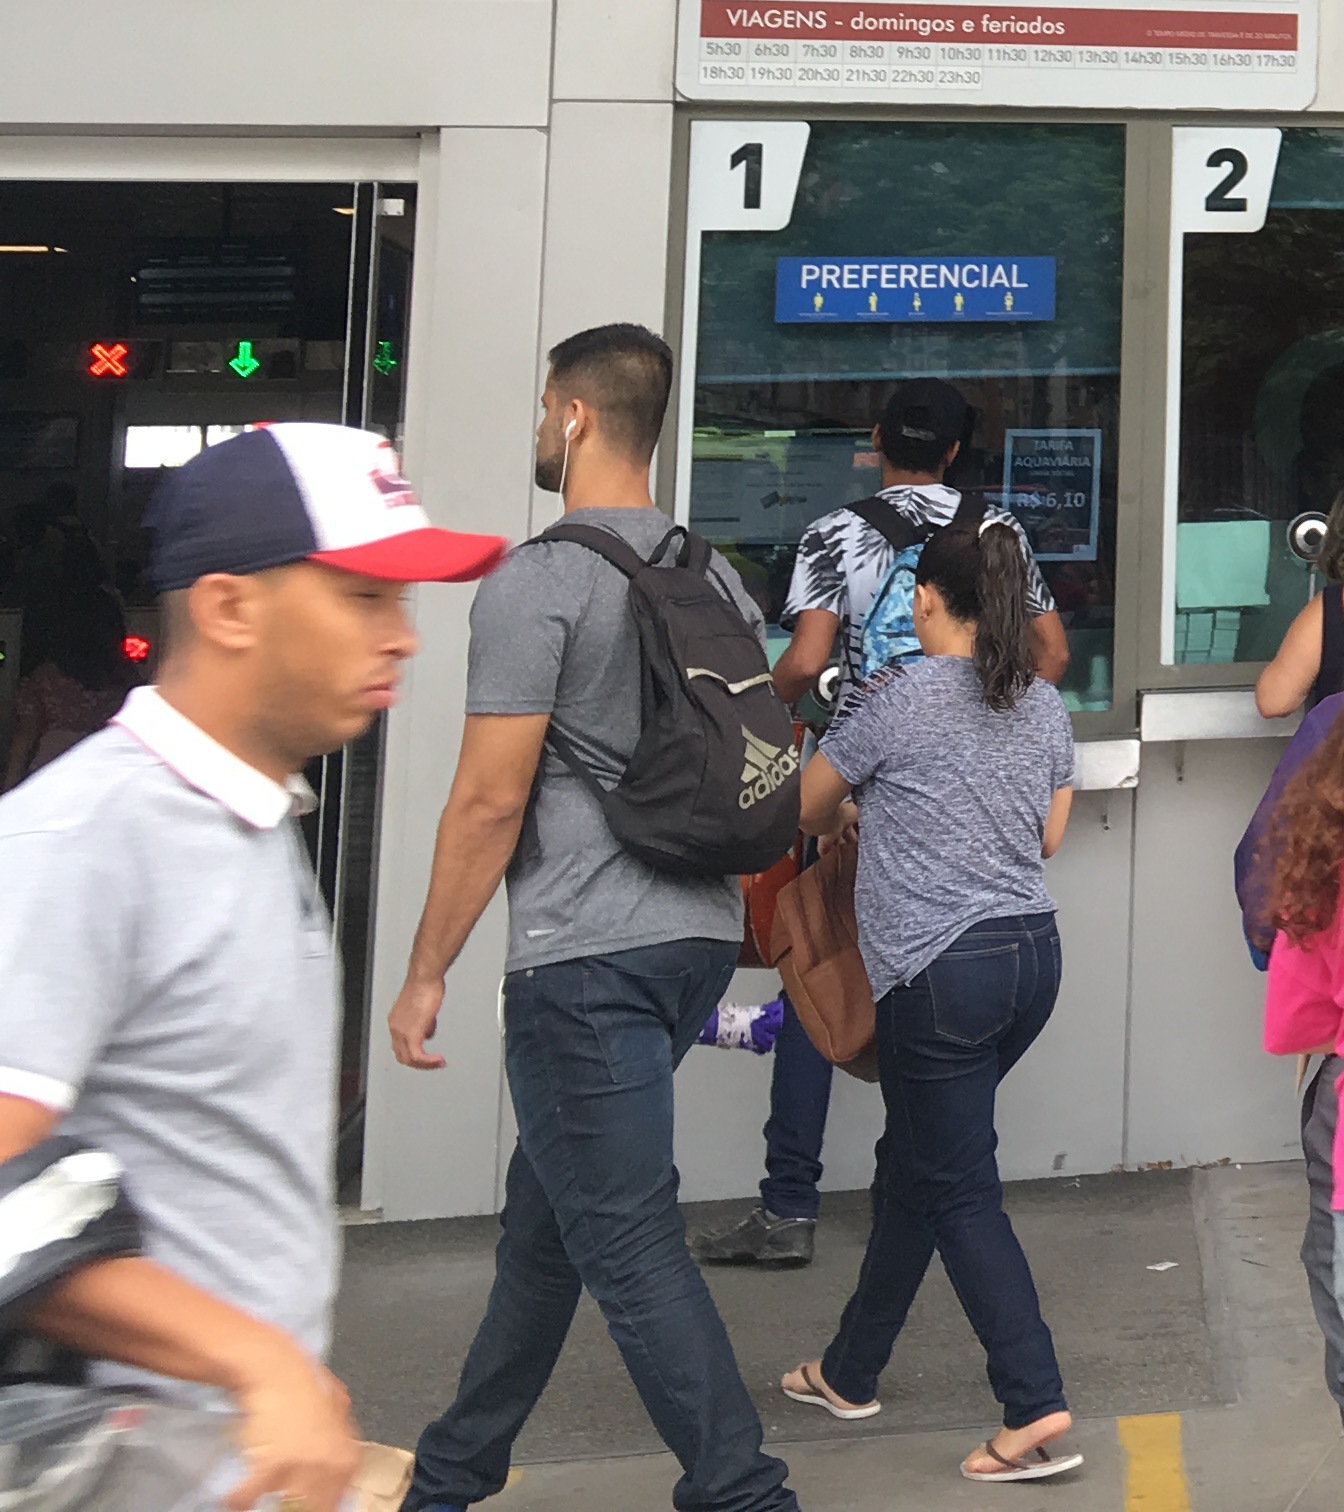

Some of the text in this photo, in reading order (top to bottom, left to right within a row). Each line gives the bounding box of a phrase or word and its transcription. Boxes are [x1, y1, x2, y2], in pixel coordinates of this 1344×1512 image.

[725, 8, 827, 29] VIAGENS
[850, 10, 956, 36] domingos
[961, 19, 975, 33] e
[980, 13, 1066, 35] feriados
[730, 142, 763, 210] 1
[1204, 147, 1249, 212] 2
[800, 263, 1029, 290] PREFERENCIAL
[1046, 492, 1086, 509] 6,10
[738, 744, 800, 809] adidas
